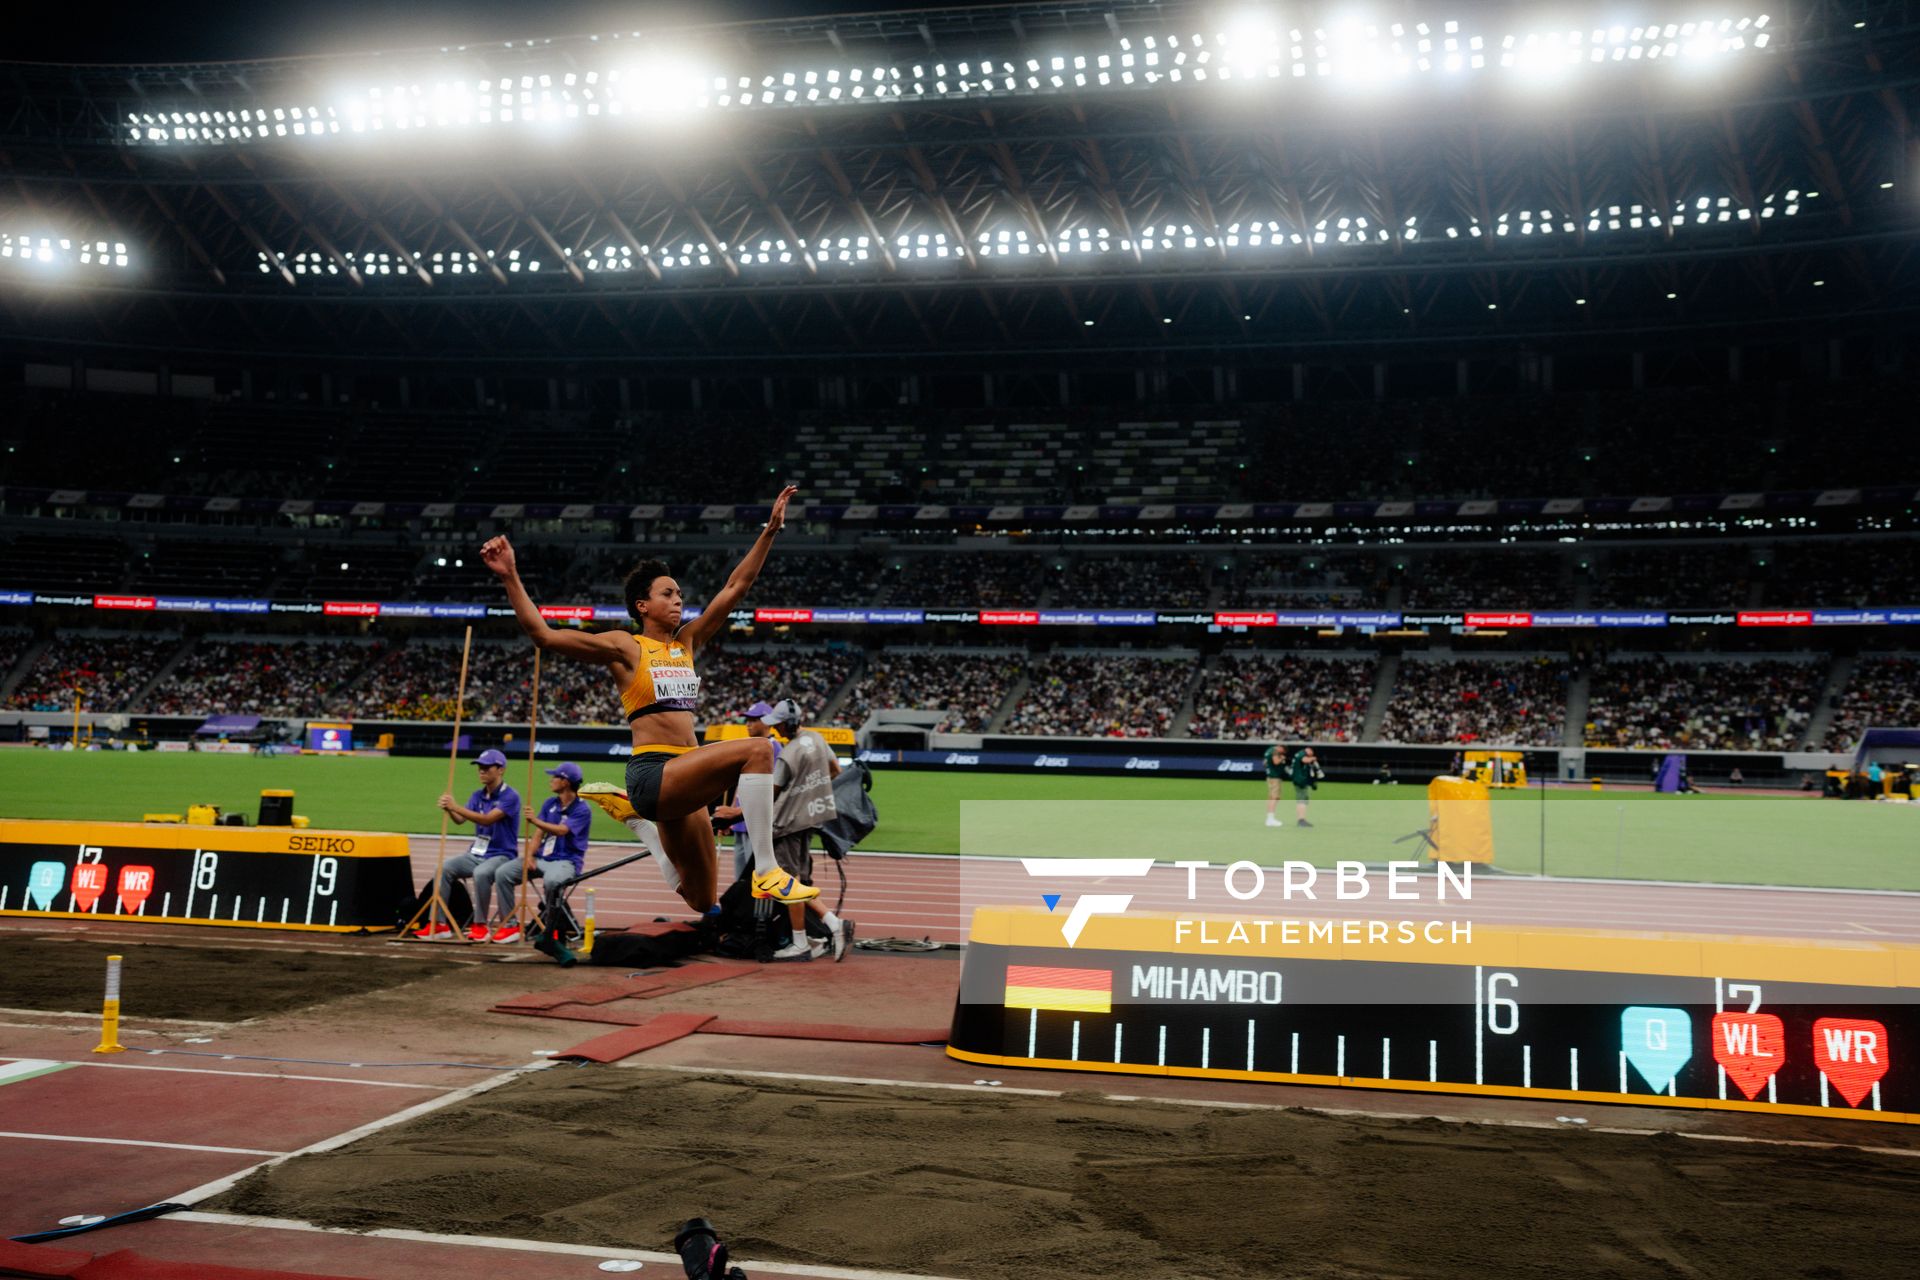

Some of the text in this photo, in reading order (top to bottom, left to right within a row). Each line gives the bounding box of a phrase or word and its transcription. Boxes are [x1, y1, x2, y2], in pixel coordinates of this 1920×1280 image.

[289, 836, 355, 853] SEIKO
[77, 869, 101, 889] WL
[124, 871, 150, 891] WR
[196, 852, 219, 890] 8
[316, 857, 338, 896] 9
[1131, 965, 1283, 1005] MIHAMBO
[1487, 972, 1520, 1036] 6
[1645, 1019, 1878, 1064] Q WL WR
